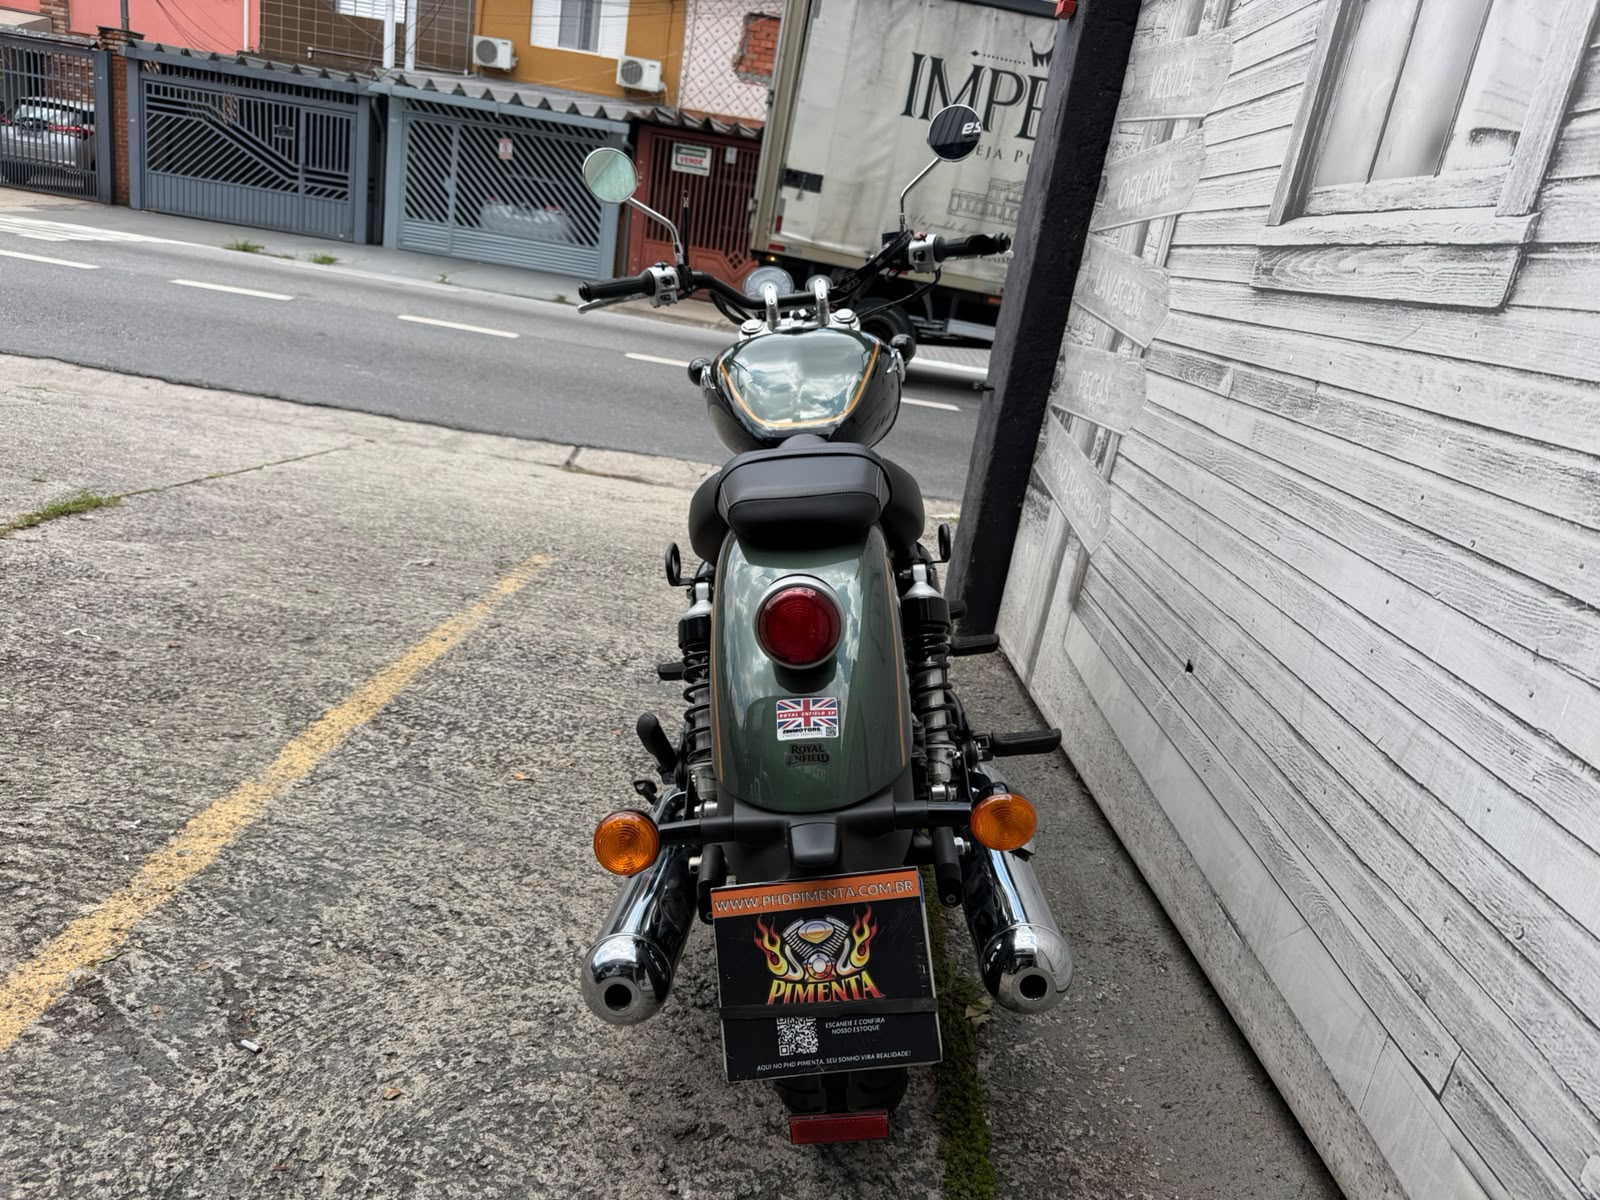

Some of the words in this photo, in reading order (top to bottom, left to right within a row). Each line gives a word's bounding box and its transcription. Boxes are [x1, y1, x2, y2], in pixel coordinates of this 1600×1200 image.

[1149, 57, 1196, 99] VENDA
[1118, 161, 1172, 210] OFICINA
[1094, 265, 1147, 317] LAVAGEM
[1076, 369, 1112, 408] PEÇAS
[788, 753, 830, 765] ENFIELD
[791, 744, 825, 754] ROYAL
[715, 879, 913, 912] WWW.PHDPIMENTA.COM.BR
[767, 970, 886, 1005] PIMENTA
[825, 1019, 853, 1029] ESCANEIE
[858, 1016, 886, 1026] CONFIRA
[831, 1026, 852, 1035] NOSSO
[852, 1024, 880, 1033] ESTOQUE
[756, 1064, 772, 1072] AQUI
[826, 1057, 838, 1065] SEU
[838, 1055, 860, 1063] SONHO
[860, 1053, 876, 1061] VIRA
[876, 1050, 912, 1059] REALIDADE!
